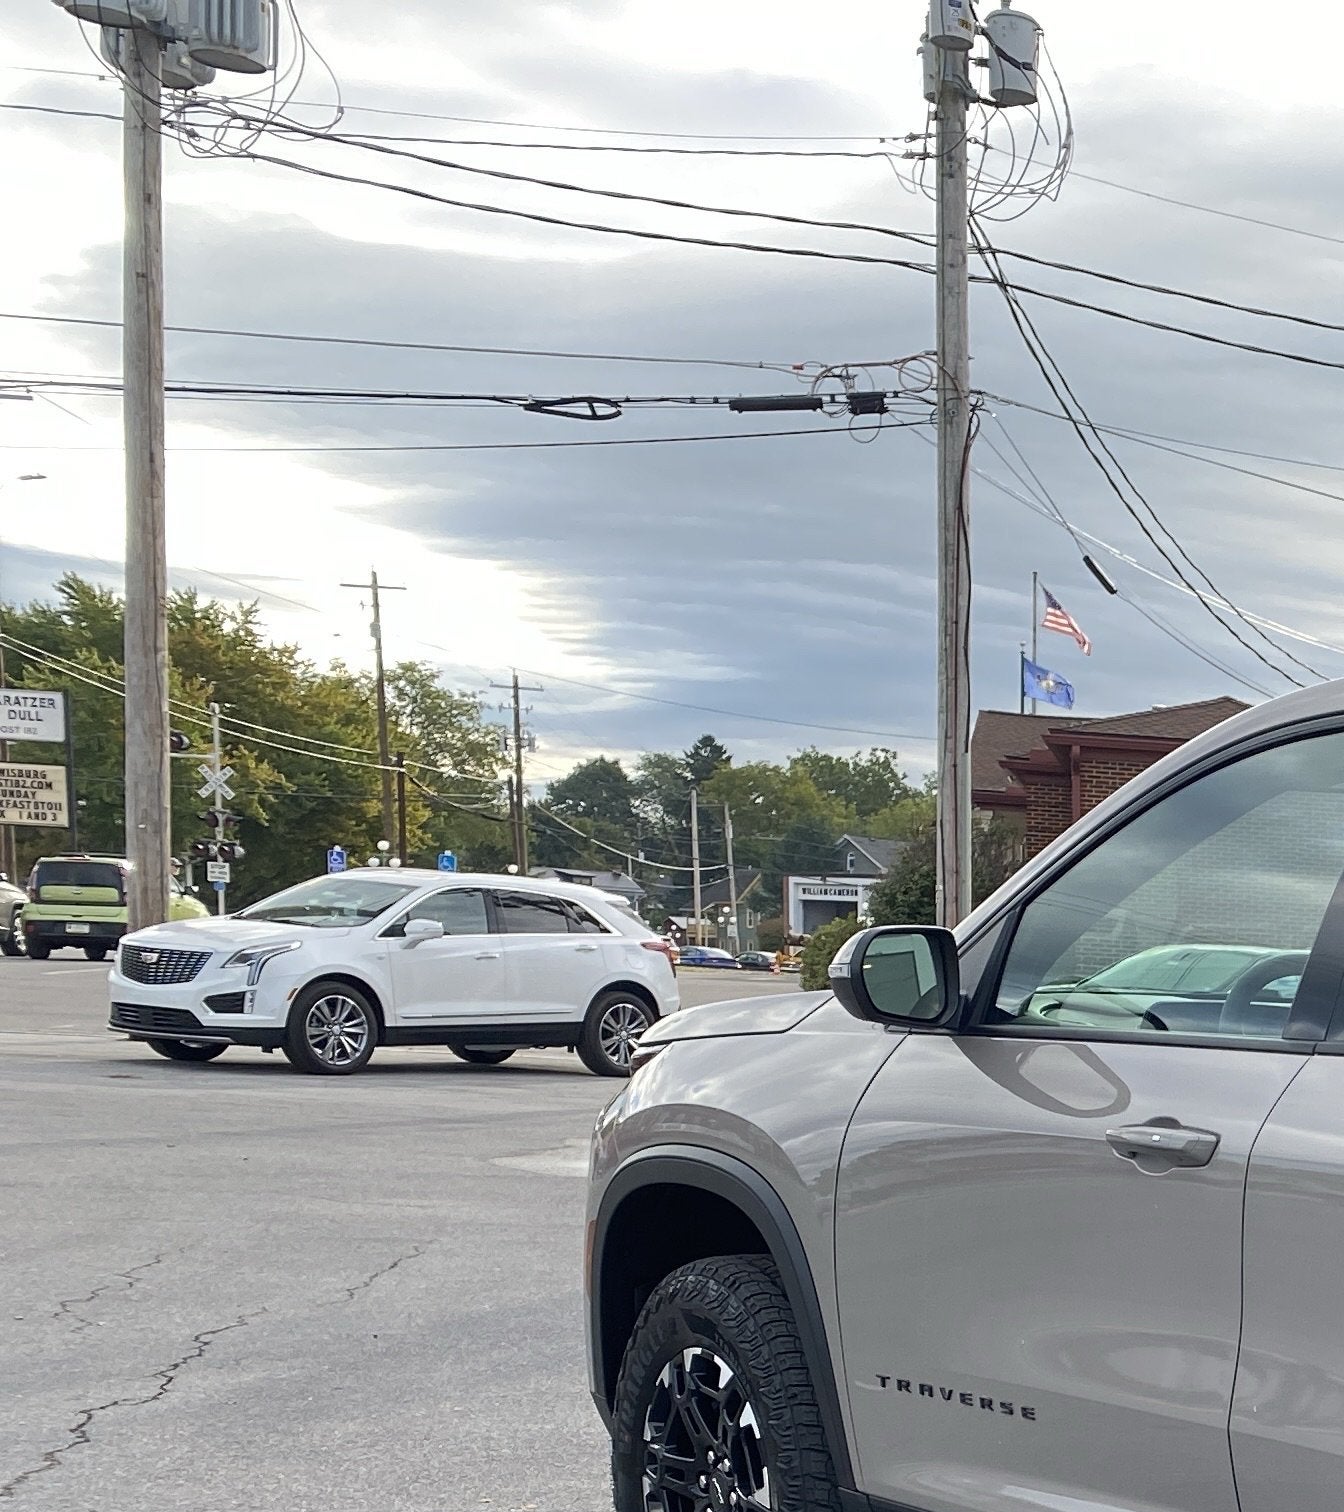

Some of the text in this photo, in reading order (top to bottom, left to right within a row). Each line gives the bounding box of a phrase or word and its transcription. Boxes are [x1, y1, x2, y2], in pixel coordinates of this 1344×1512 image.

[8, 709, 43, 722] DULL
[0, 789, 37, 799] UNDAY
[27, 811, 47, 821] AND
[51, 812, 57, 821] 3
[875, 1373, 1036, 1421] TRAVERSE
